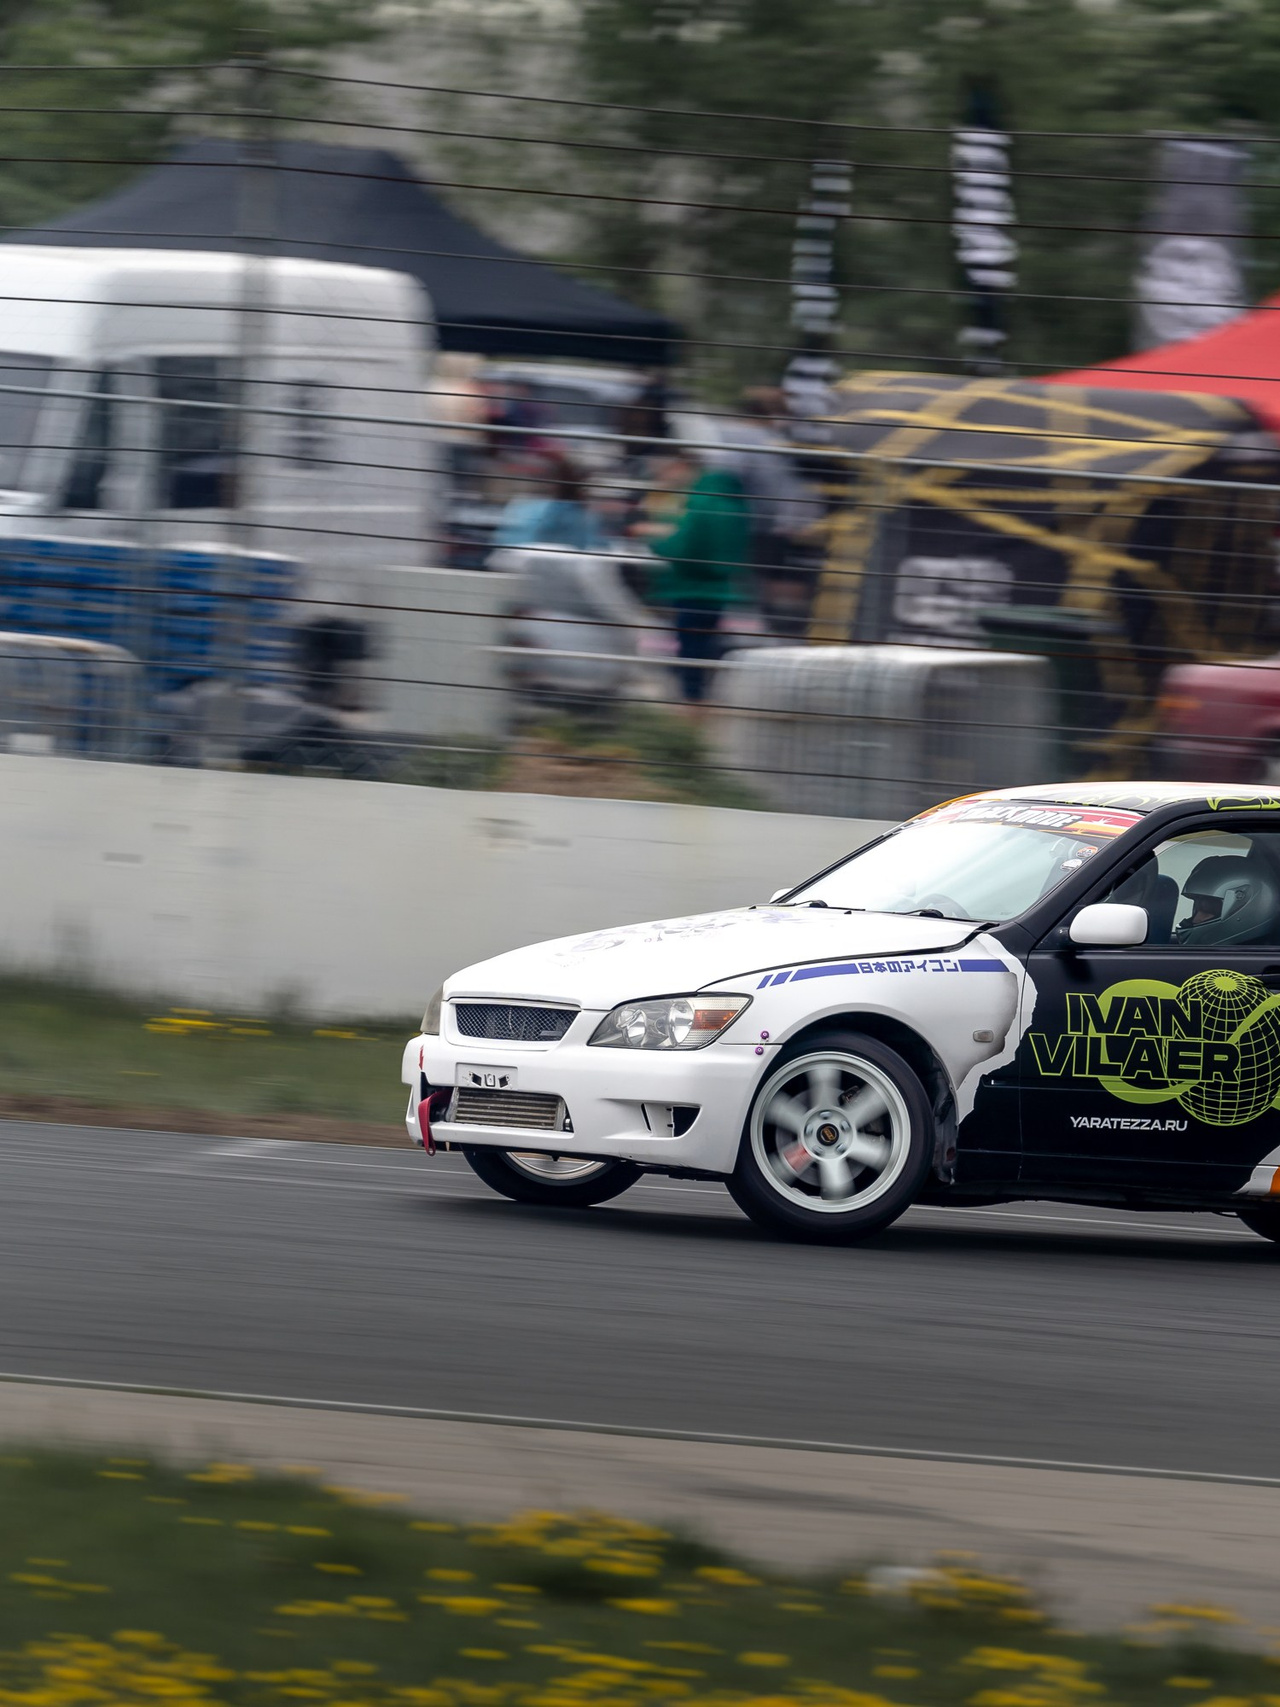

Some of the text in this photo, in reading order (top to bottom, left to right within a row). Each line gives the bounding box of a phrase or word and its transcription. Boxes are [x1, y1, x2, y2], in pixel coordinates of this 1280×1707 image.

[858, 960, 960, 974] 日本のアイコン
[1066, 993, 1203, 1040] IVAN
[1029, 1033, 1241, 1083] VILAER
[1070, 1116, 1188, 1132] YARATEZZA.RU
